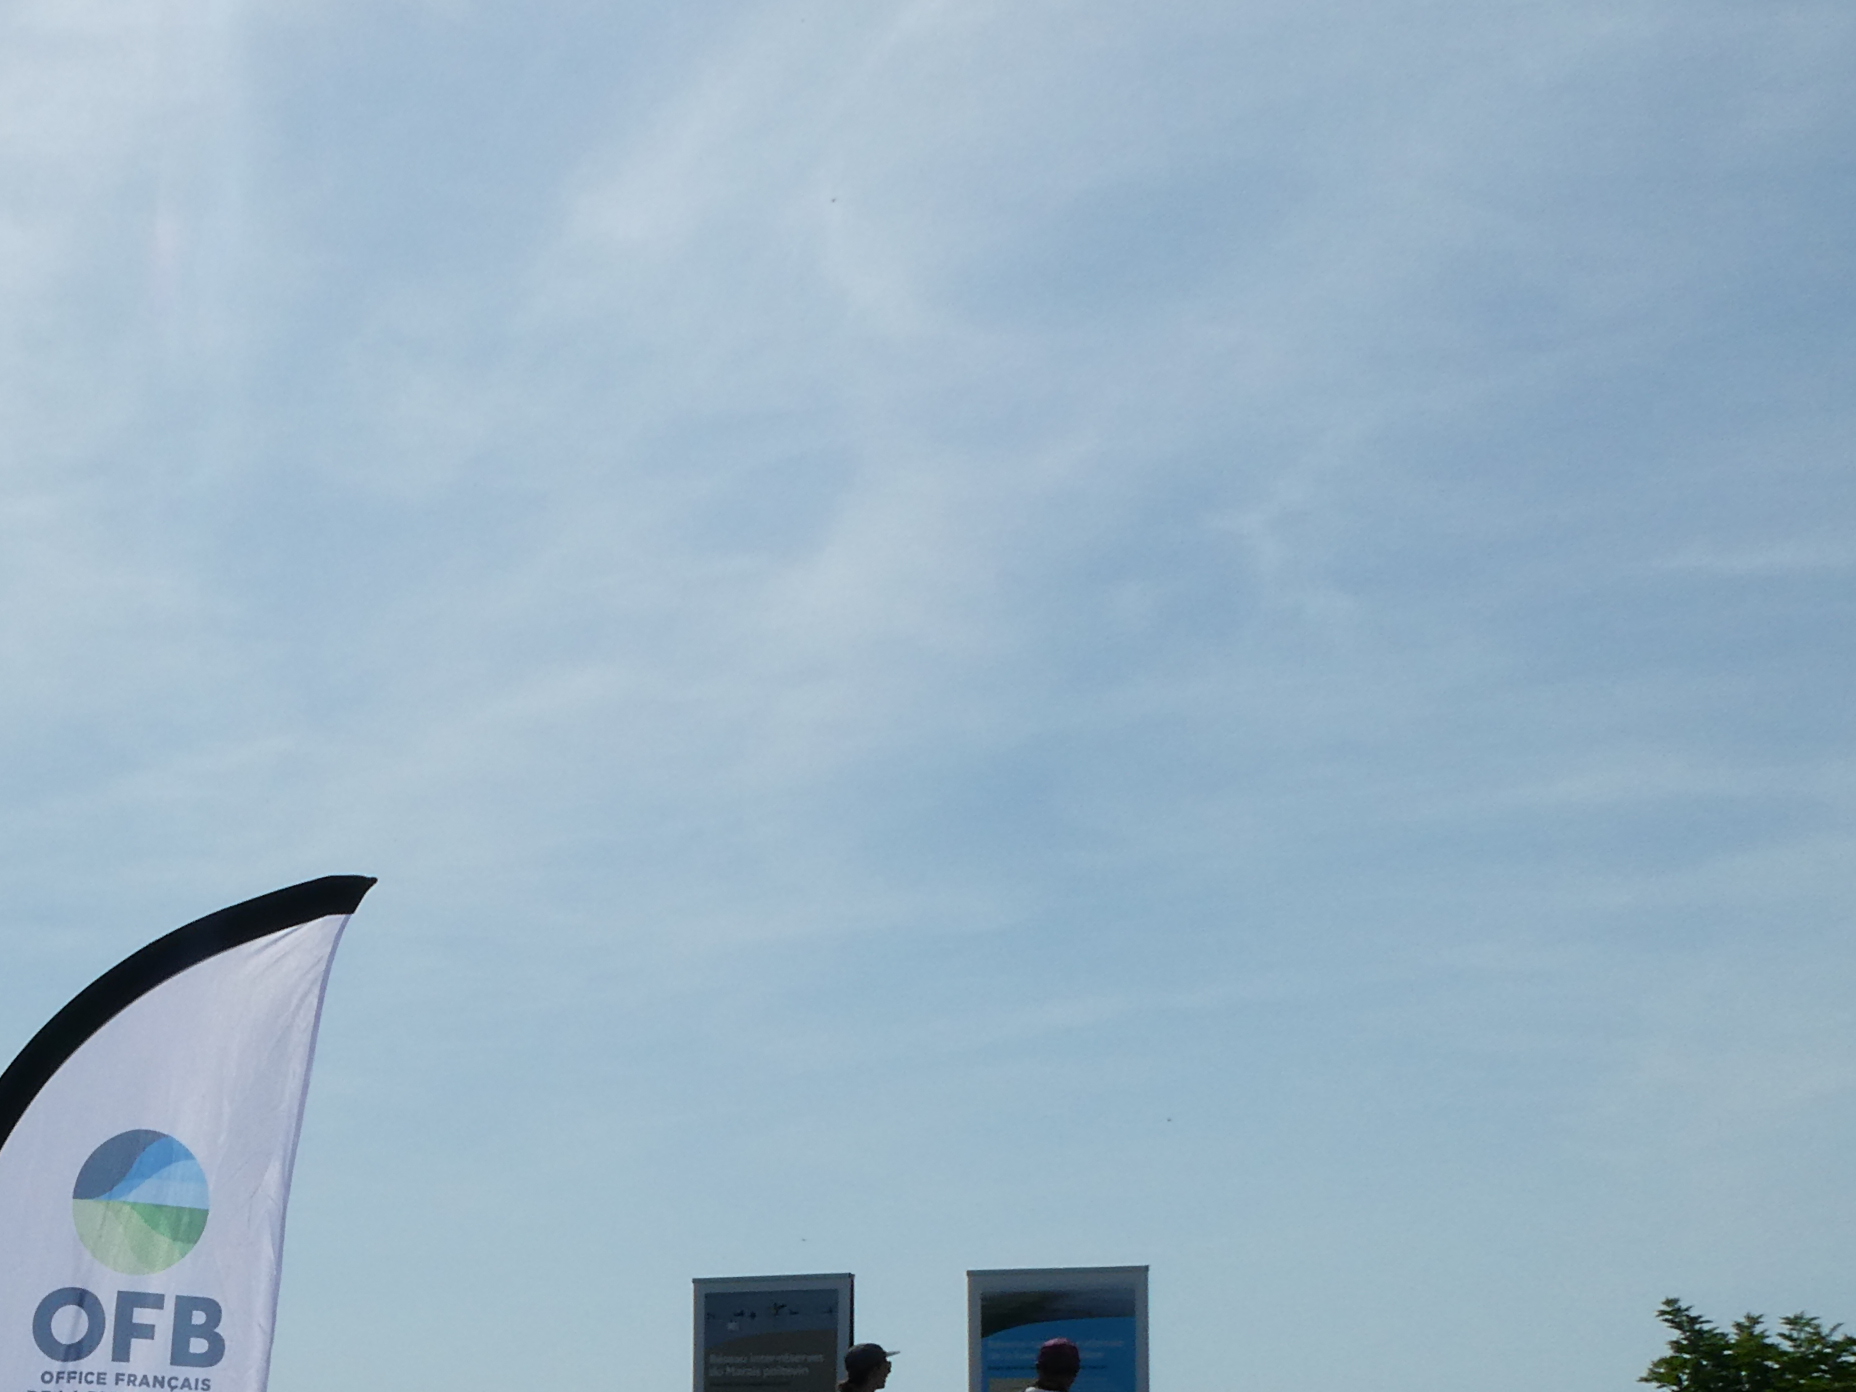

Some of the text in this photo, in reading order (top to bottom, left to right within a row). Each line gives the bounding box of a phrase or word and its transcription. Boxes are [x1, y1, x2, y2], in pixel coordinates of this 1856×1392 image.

[31, 1286, 226, 1369] OFB
[40, 1370, 212, 1392] OFFICE FRANÇAIS
